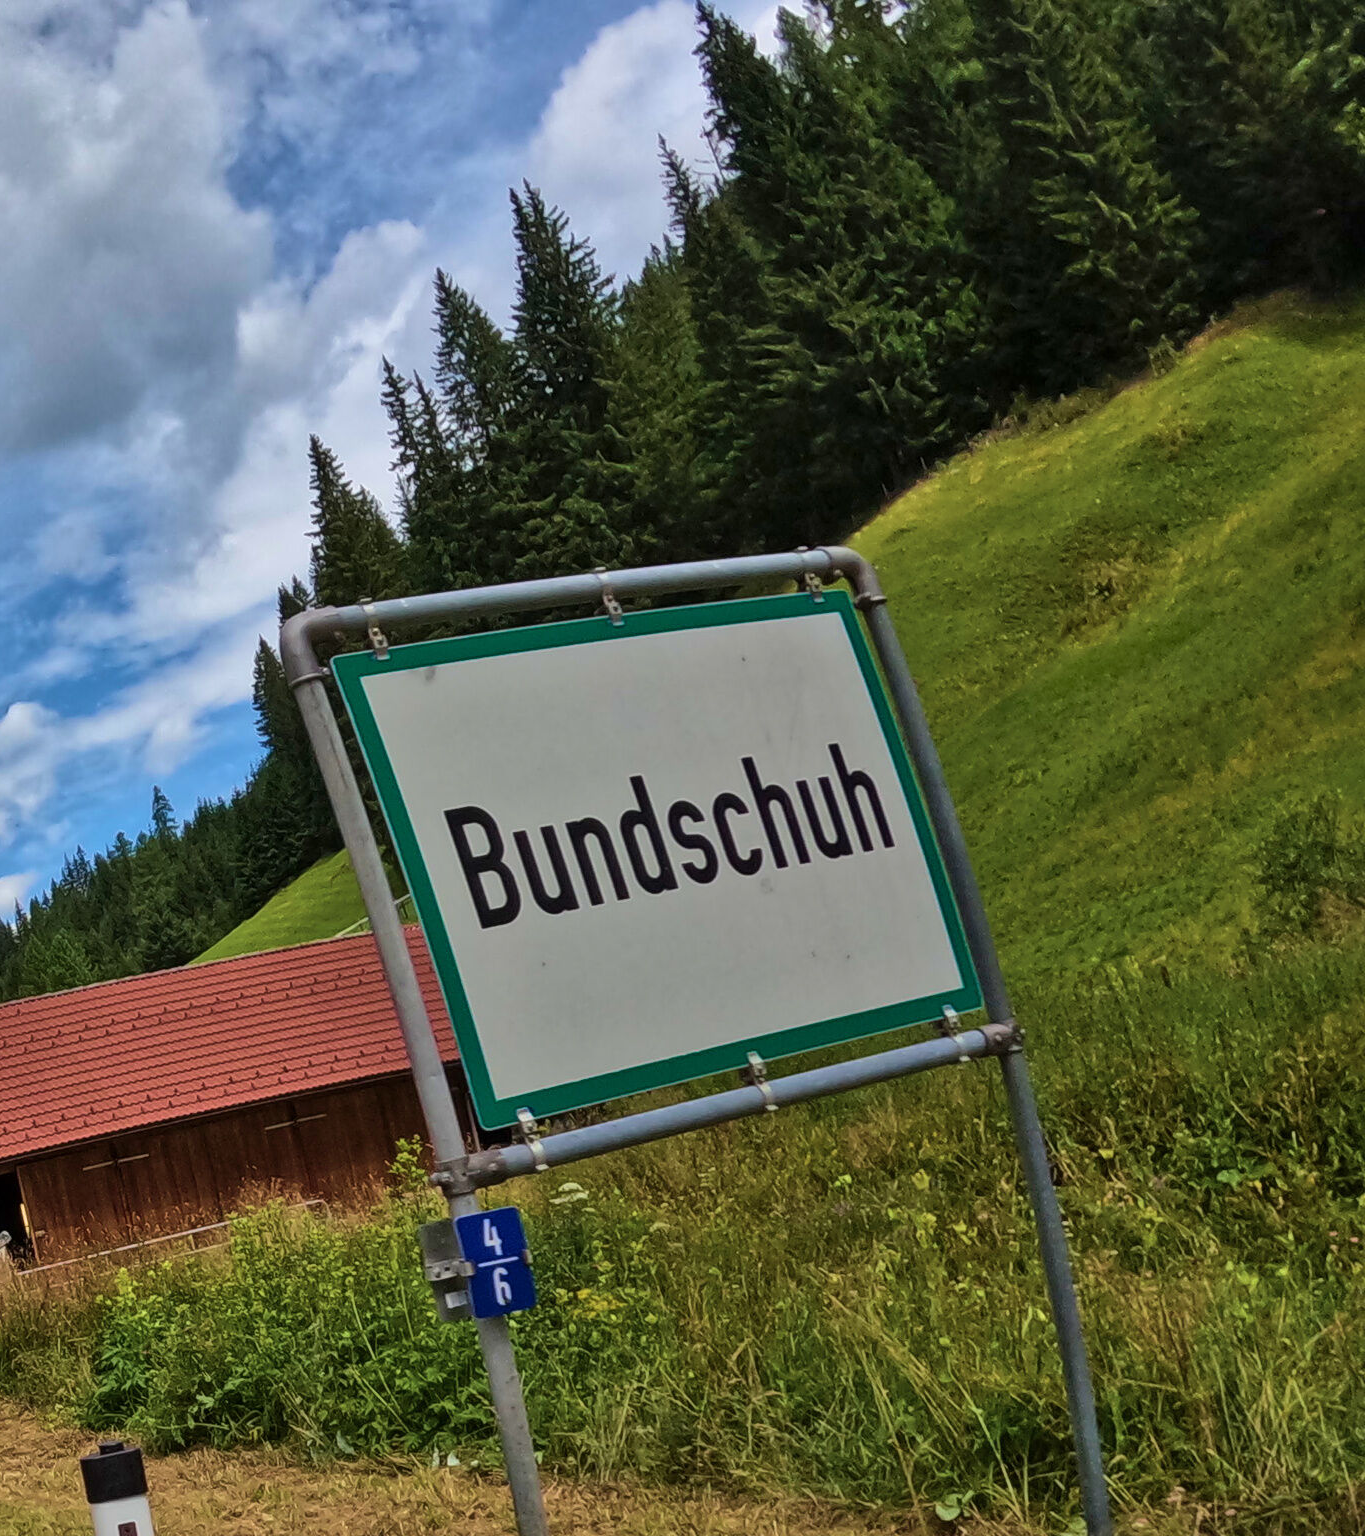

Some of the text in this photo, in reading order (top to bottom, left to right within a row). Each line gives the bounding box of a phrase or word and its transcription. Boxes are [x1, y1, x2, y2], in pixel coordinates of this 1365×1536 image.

[443, 743, 895, 929] Bundschuh
[483, 1218, 504, 1256] 4
[492, 1267, 513, 1306] 6
